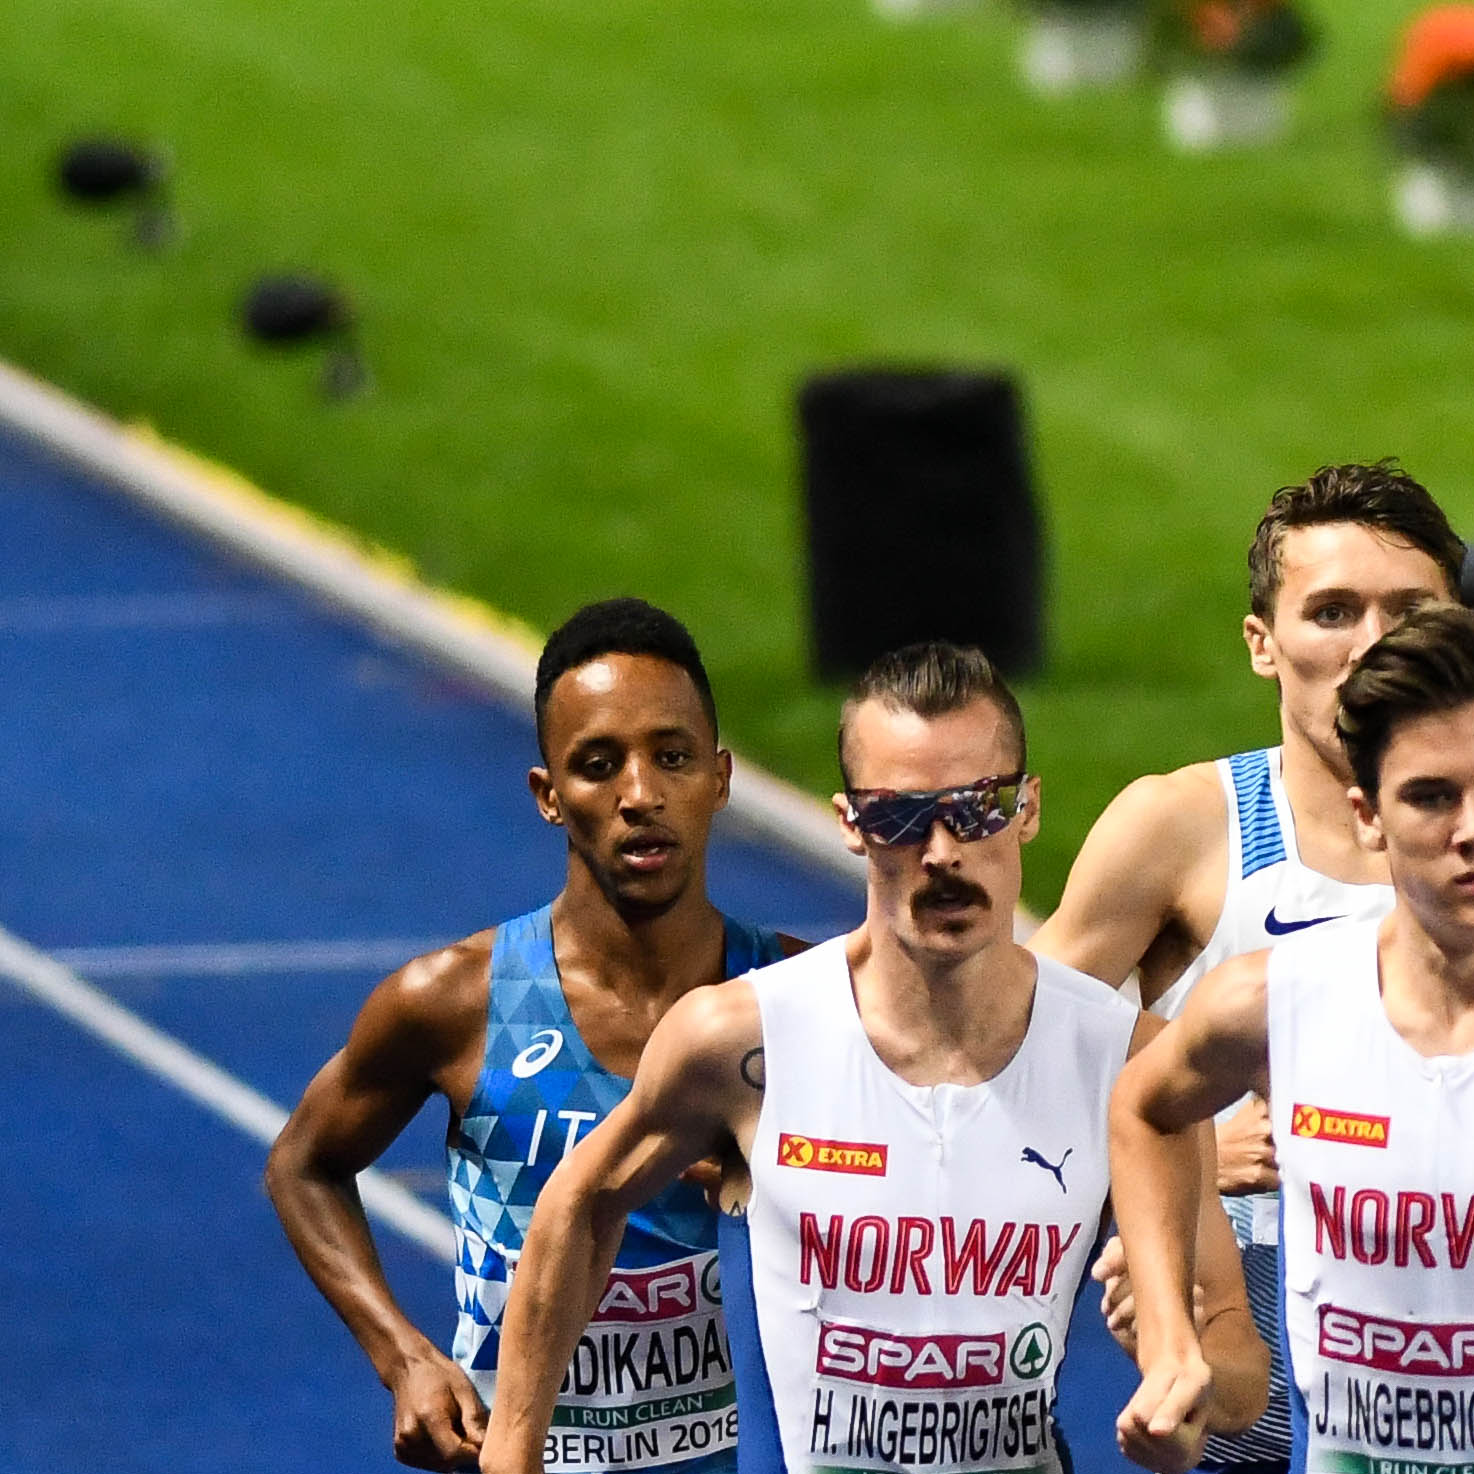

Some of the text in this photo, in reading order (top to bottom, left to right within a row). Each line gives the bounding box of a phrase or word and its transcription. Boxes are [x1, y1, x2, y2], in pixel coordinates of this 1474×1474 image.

[1324, 1118, 1386, 1141] EXTRA
[818, 1147, 884, 1168] EXTRA
[800, 1212, 1081, 1296] NORWAY
[822, 1332, 1001, 1381] SPAR
[570, 1409, 576, 1425] I
[583, 1406, 629, 1425] RUN
[811, 1388, 838, 1455] H.
[1316, 1372, 1338, 1436] J.
[545, 1411, 737, 1464] BERLIN 2018
